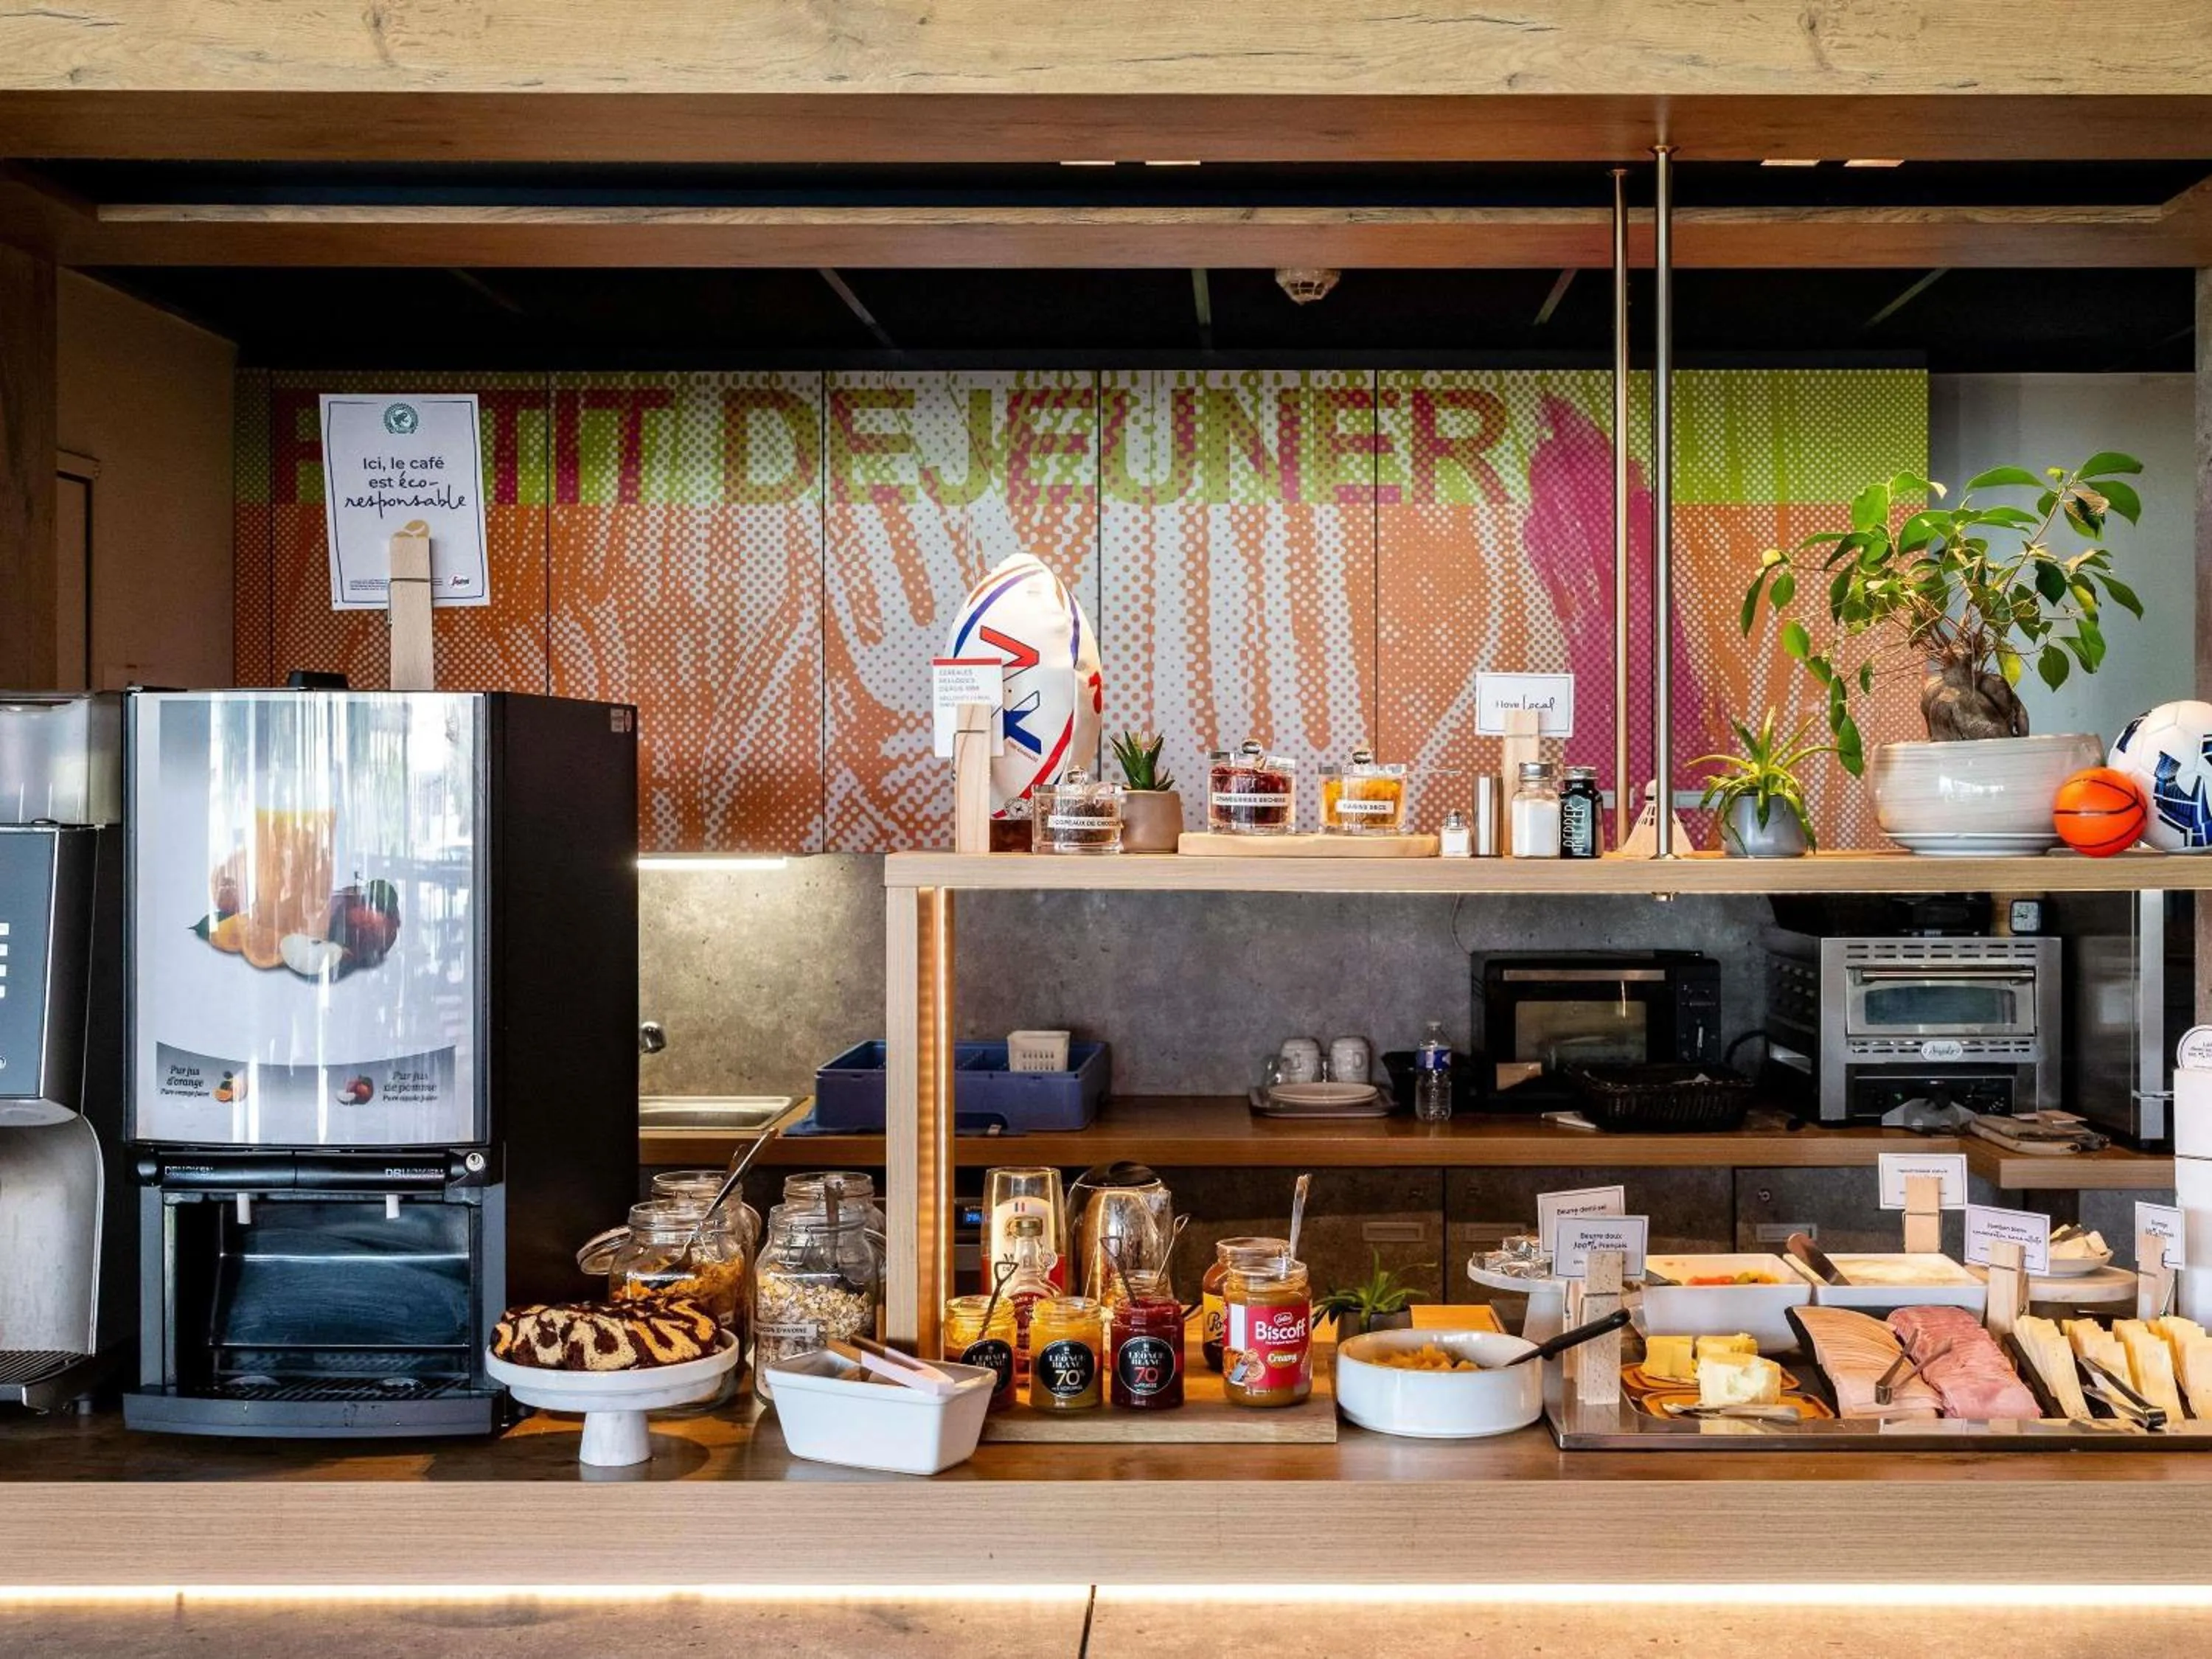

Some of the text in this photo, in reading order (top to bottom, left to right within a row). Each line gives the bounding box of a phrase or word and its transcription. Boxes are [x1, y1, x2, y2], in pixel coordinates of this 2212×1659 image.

[273, 389, 676, 504] PTIT
[363, 457, 445, 472] Ici, le café
[369, 470, 439, 489] est éco-
[344, 484, 467, 519] responsable
[170, 1065, 186, 1075] Pur
[166, 1076, 204, 1089] d'orange
[1255, 1318, 1305, 1340] Biscoff
